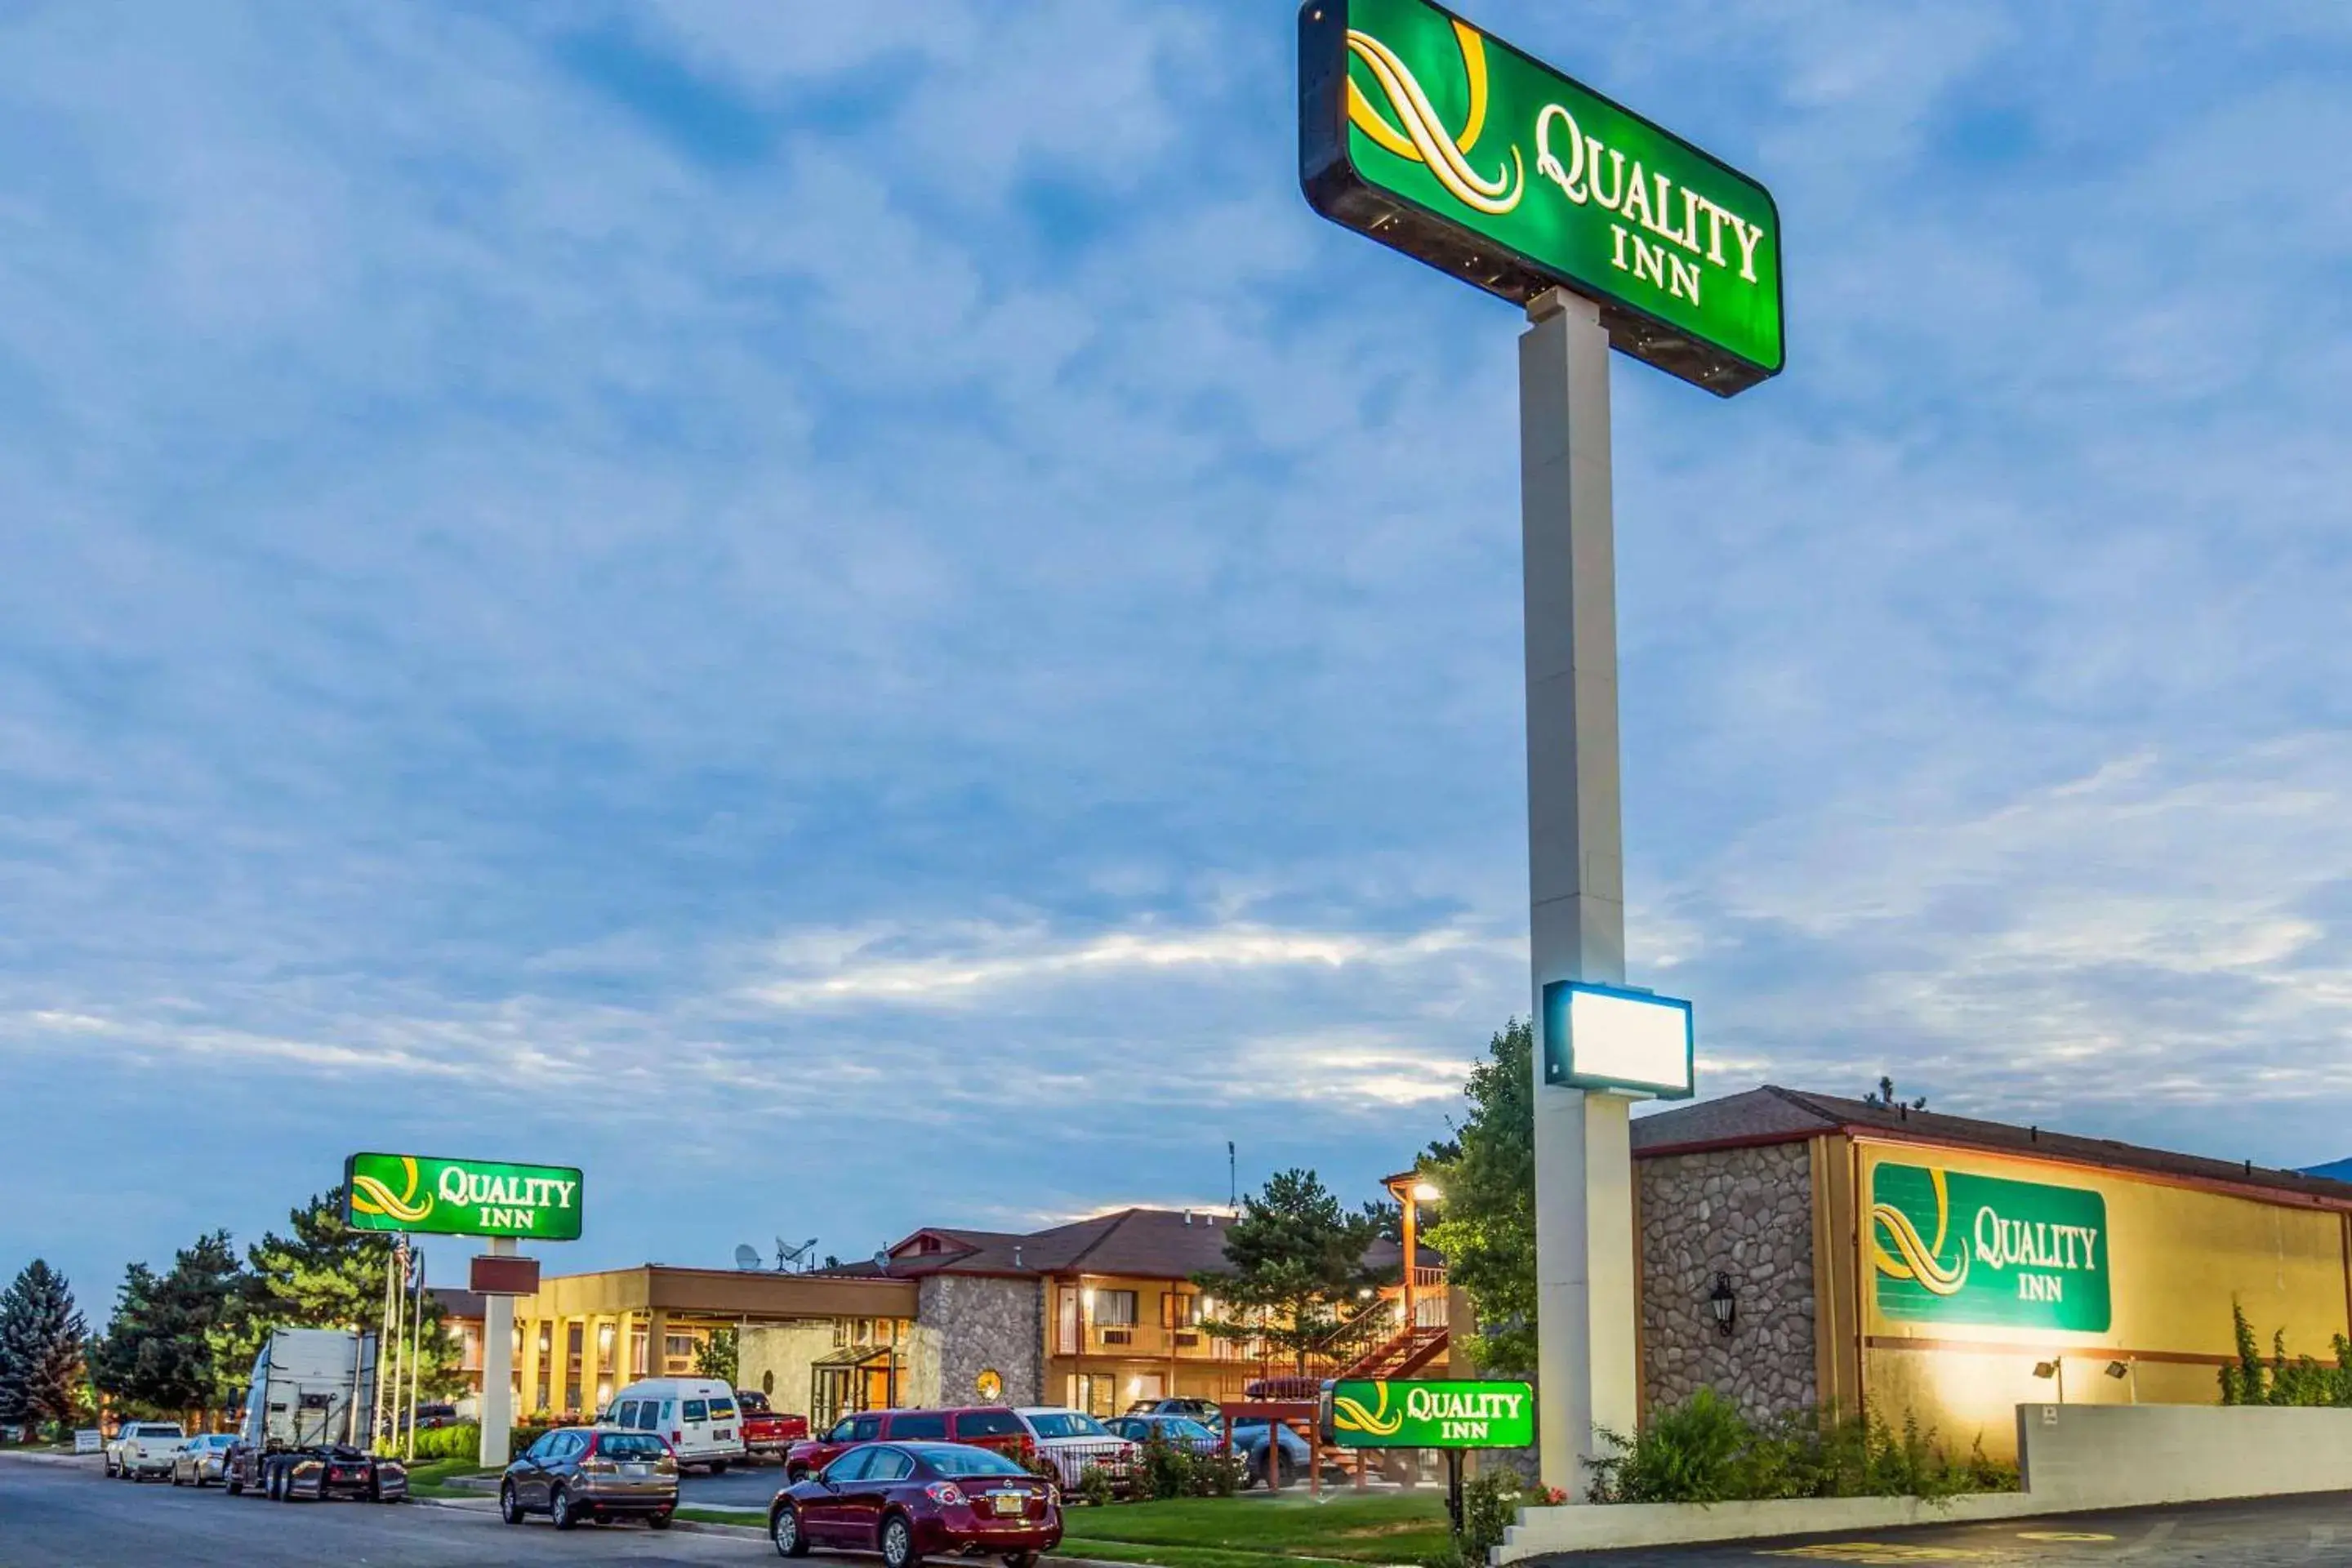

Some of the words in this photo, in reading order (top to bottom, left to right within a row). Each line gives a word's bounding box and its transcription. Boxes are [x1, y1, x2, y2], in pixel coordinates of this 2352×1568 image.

[1536, 103, 1762, 284] QUALITY
[1610, 223, 1702, 307] INN
[439, 1165, 576, 1209] QUALITY
[479, 1207, 535, 1229] INN
[1974, 1205, 2098, 1270] QUALITY
[2018, 1273, 2063, 1303] INN
[1406, 1388, 1523, 1422] QUALITY
[1441, 1422, 1489, 1439] INN
